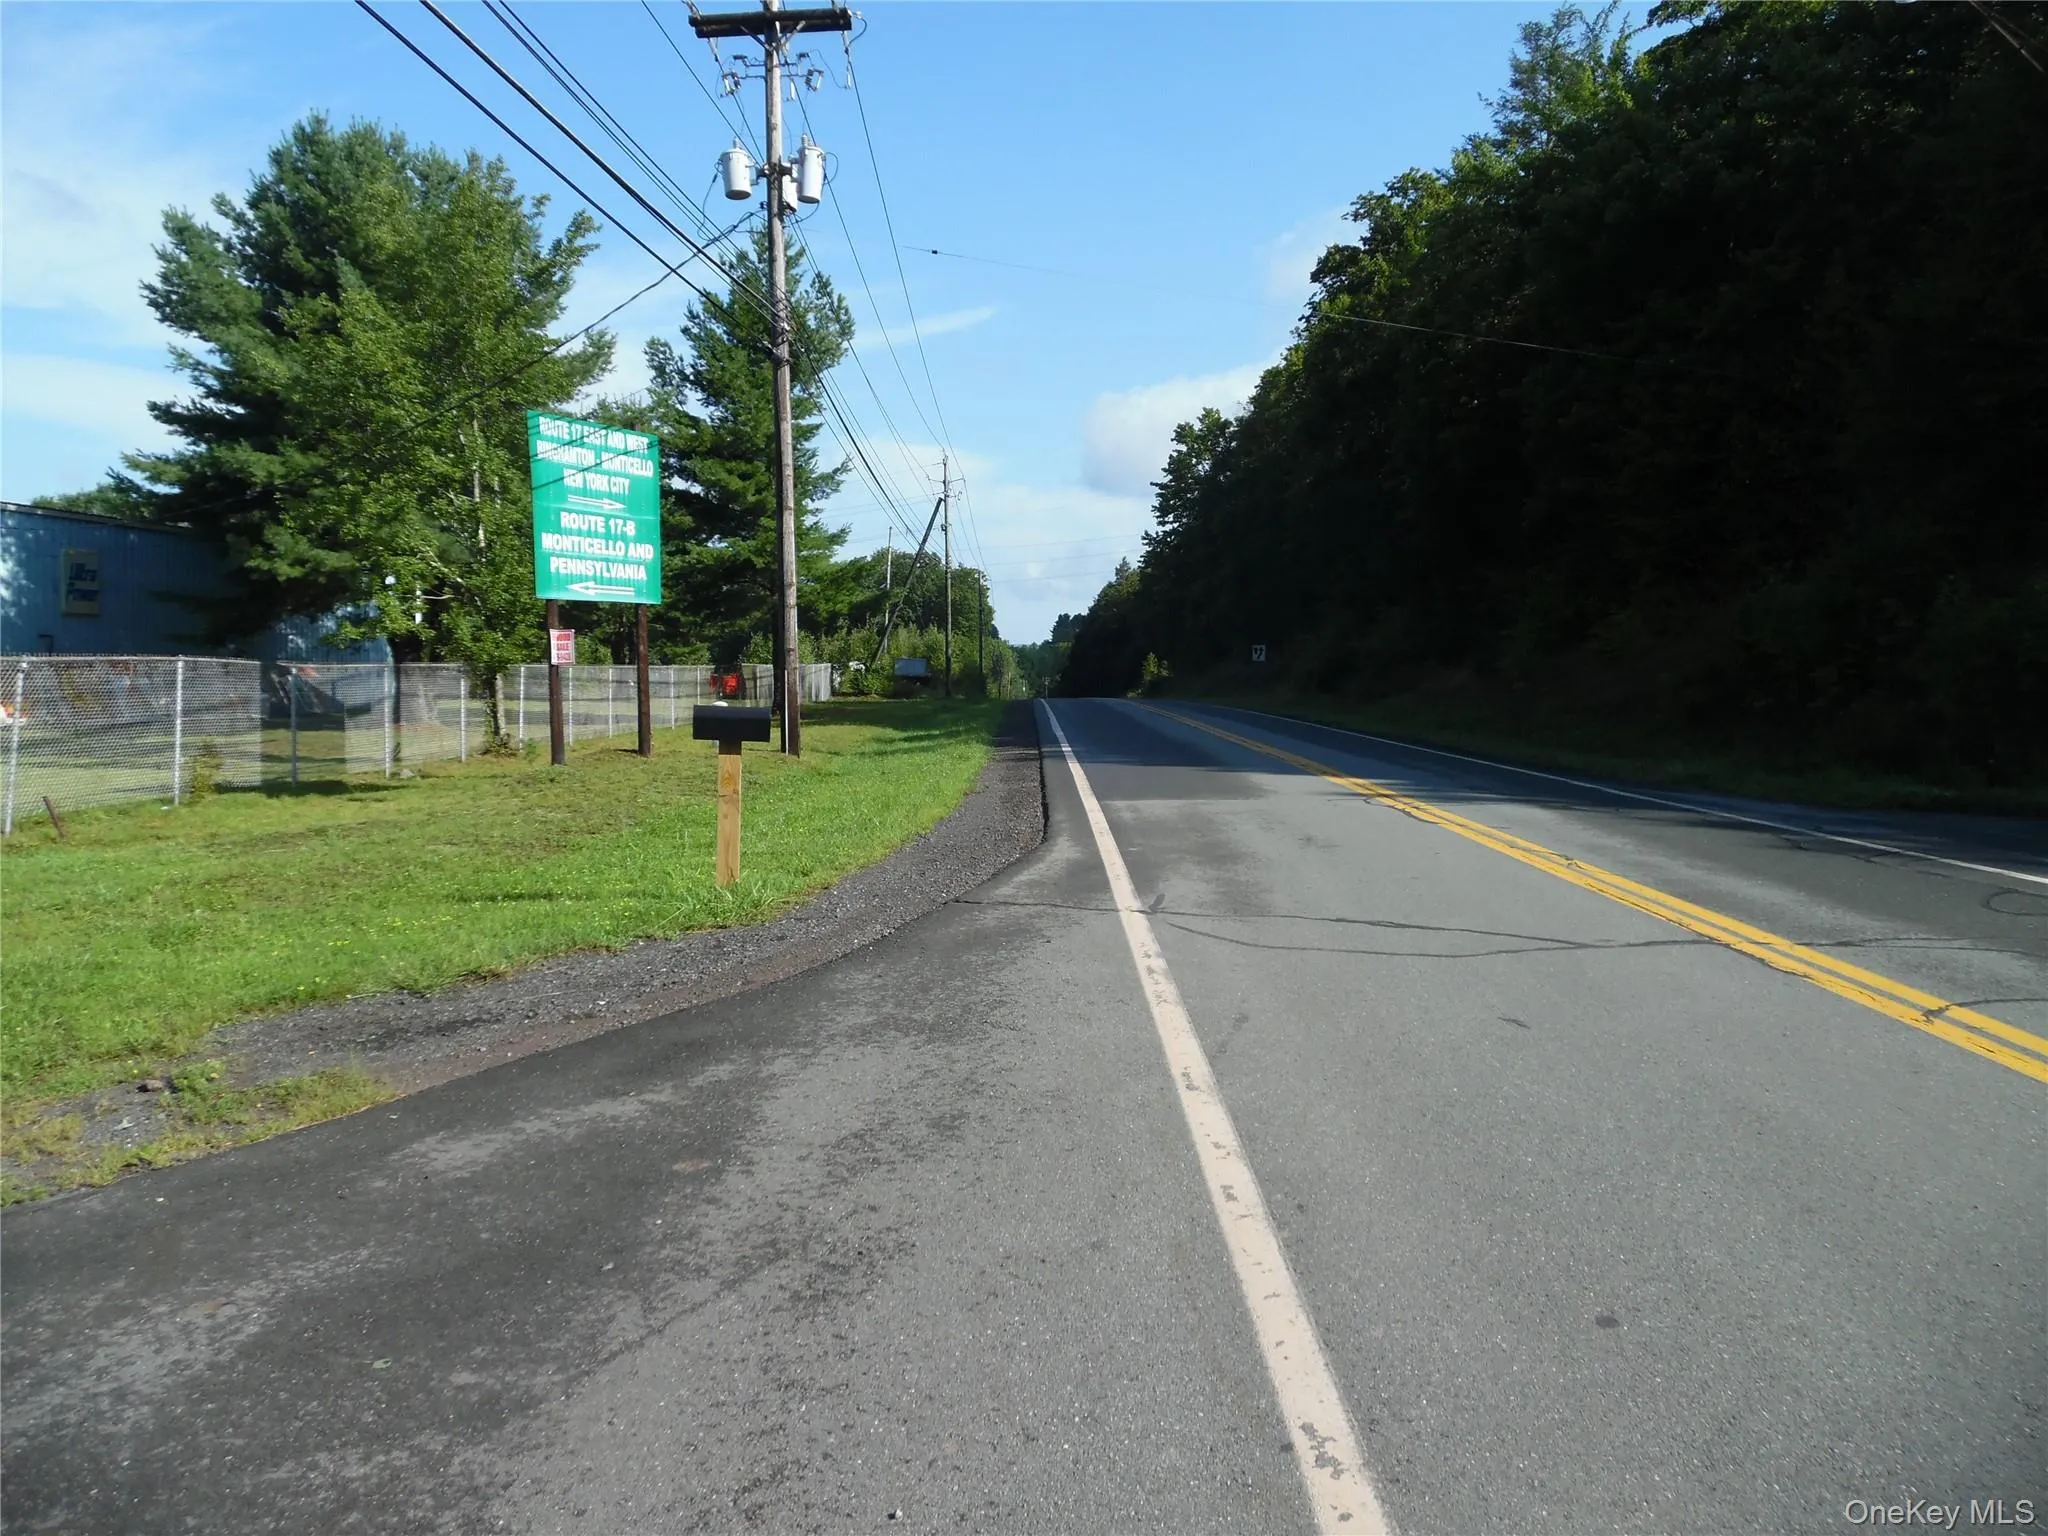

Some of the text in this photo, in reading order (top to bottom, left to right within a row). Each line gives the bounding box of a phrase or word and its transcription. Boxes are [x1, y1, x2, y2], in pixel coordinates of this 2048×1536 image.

[571, 423, 582, 441] 17
[607, 430, 626, 449] AND
[601, 451, 654, 477] MONTICELLO
[585, 472, 610, 492] YORK
[610, 476, 631, 496] CITY
[560, 511, 636, 536] ROUTE 17-B
[541, 532, 654, 560] MONTICELLO AND
[549, 556, 648, 581] PENNSYLVANIA
